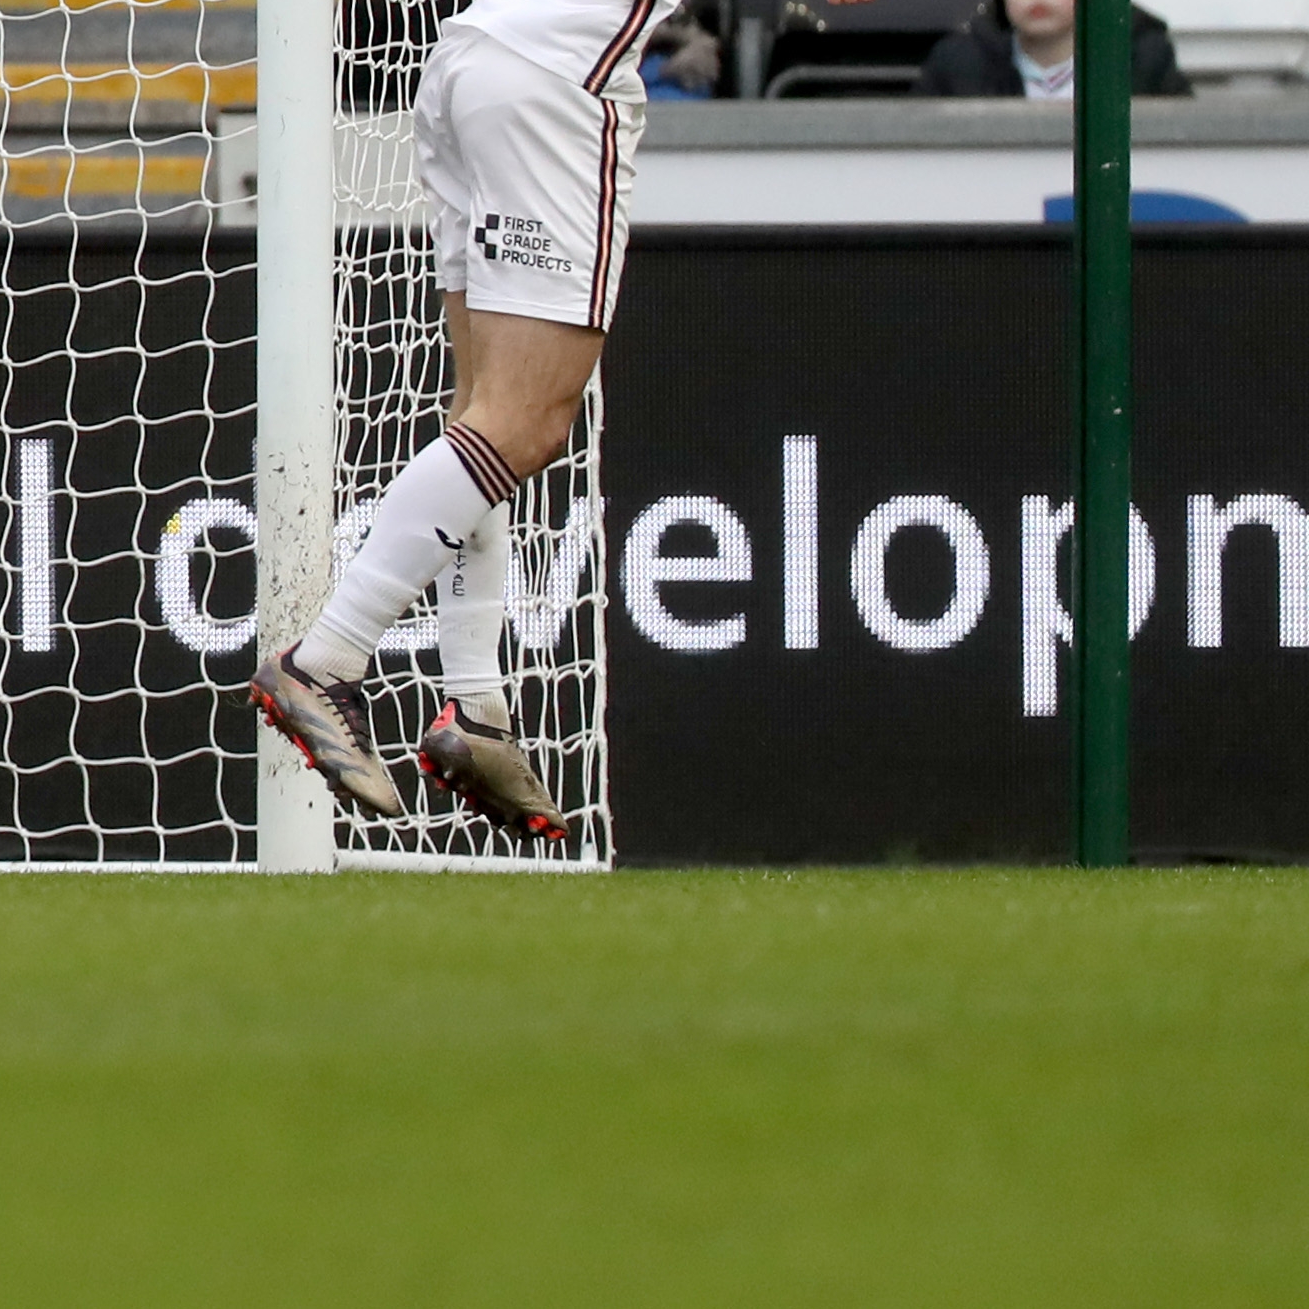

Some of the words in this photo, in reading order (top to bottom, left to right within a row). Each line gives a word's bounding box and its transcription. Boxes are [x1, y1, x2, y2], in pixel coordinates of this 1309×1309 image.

[504, 216, 543, 233] FIRST
[502, 233, 552, 252] GRADE
[501, 249, 572, 273] PROJECTS
